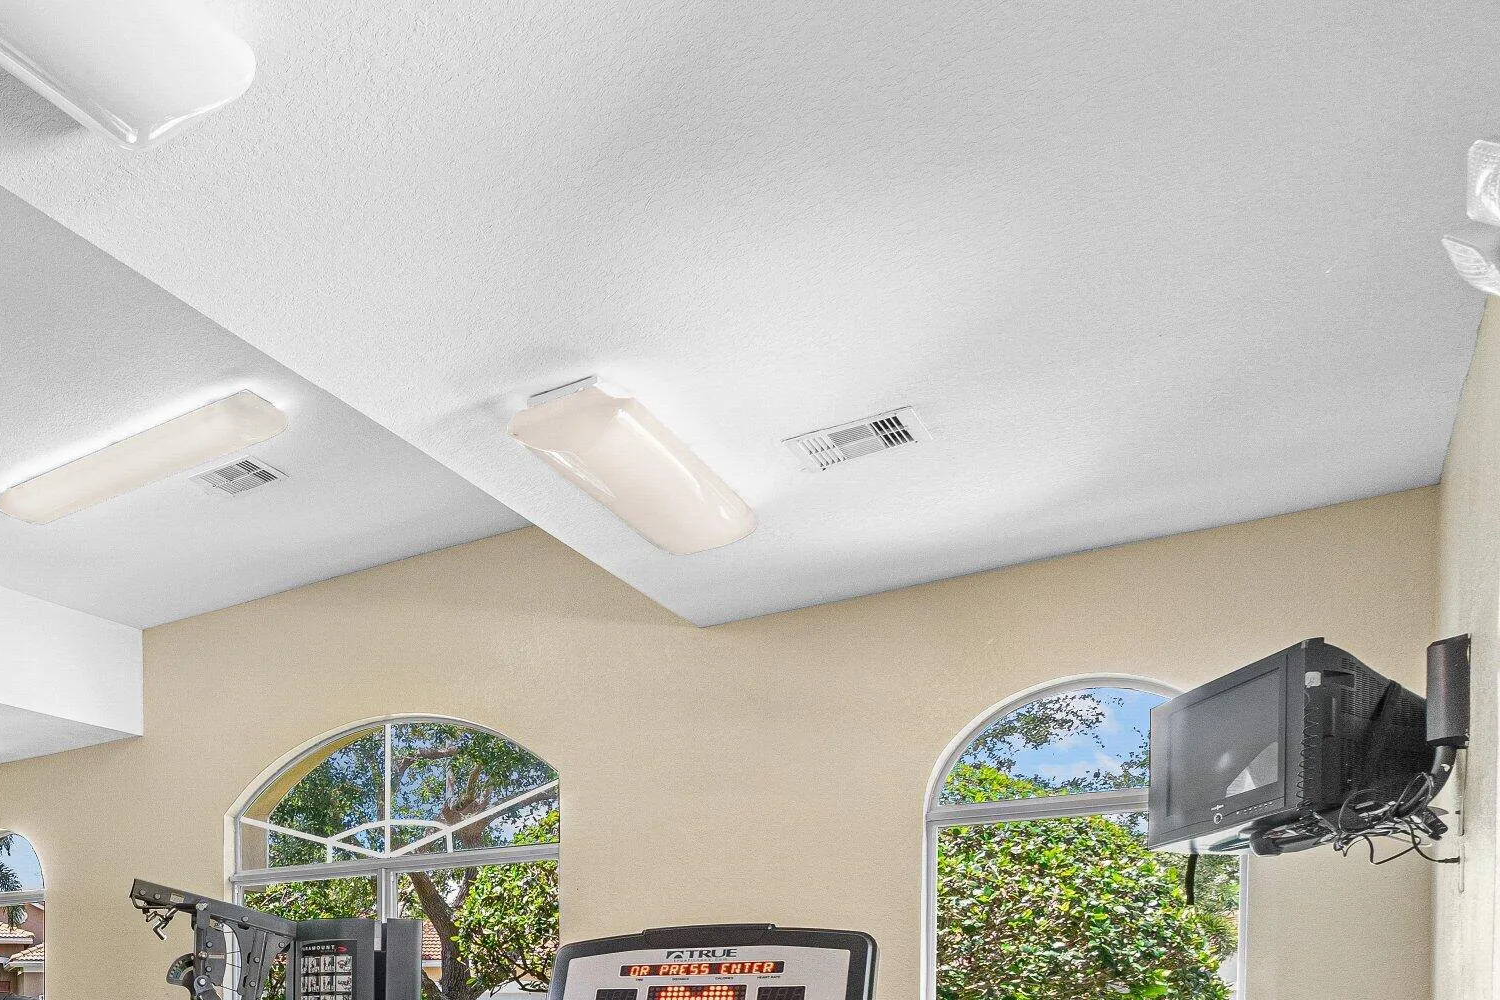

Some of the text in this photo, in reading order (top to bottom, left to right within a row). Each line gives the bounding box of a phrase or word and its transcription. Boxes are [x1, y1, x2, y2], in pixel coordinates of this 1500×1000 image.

[686, 948, 737, 958] TRUE
[630, 962, 774, 976] OR PRESS ENTER
